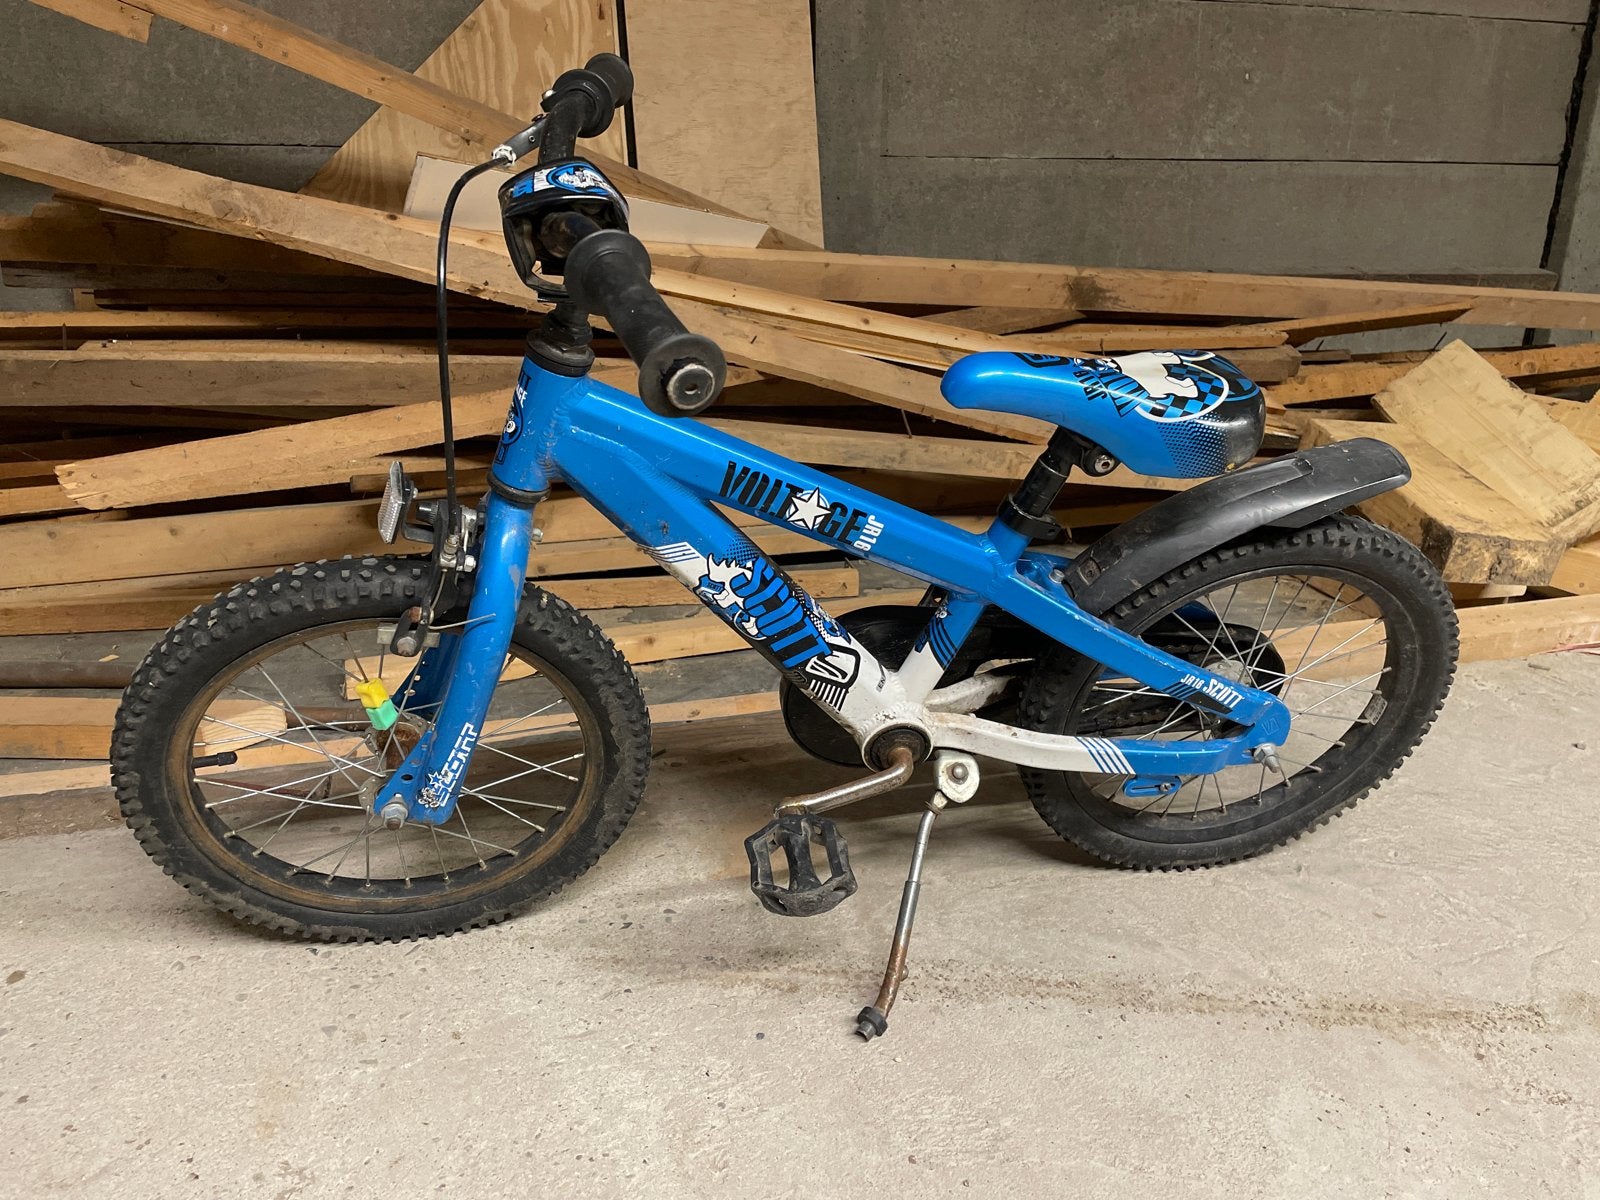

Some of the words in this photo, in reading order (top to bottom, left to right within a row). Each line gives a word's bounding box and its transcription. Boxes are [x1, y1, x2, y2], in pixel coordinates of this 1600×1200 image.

[719, 461, 867, 546] VOLTGE
[854, 514, 884, 551] JR16
[728, 556, 833, 669] SCOTT
[1180, 673, 1204, 688] JR16
[1203, 678, 1245, 708] SCOTT
